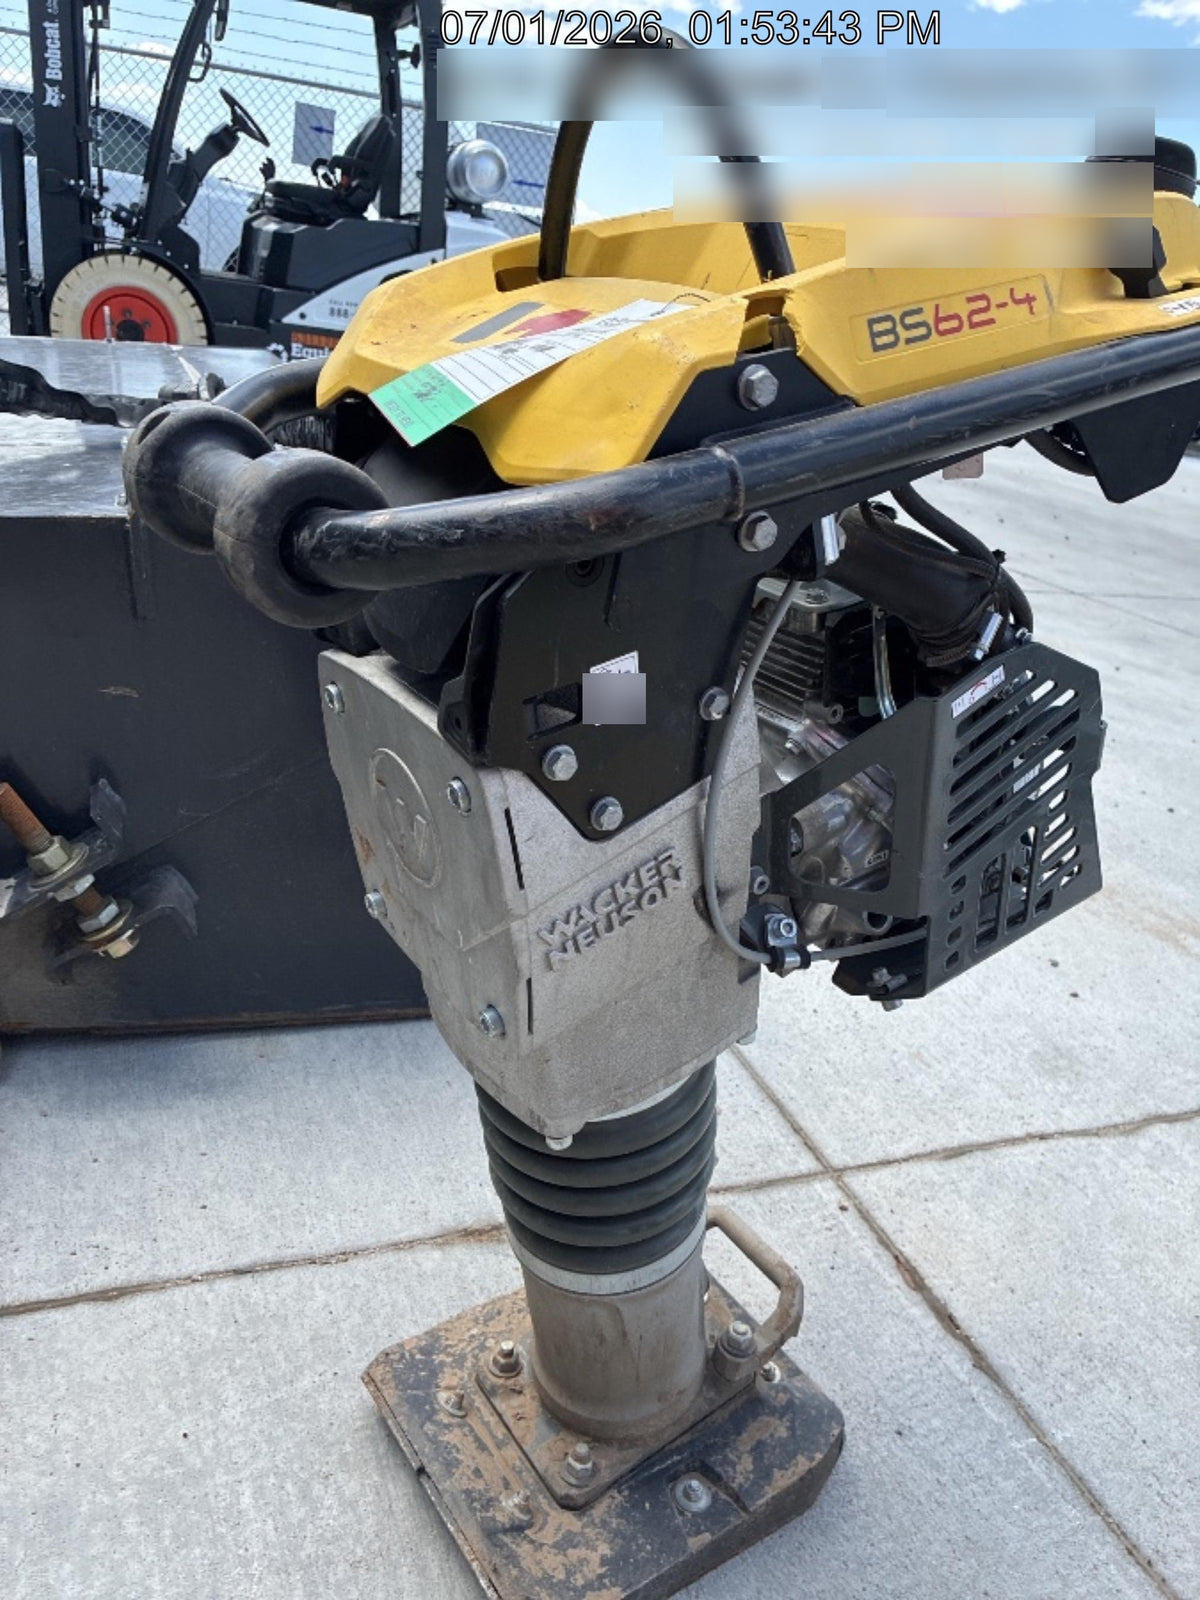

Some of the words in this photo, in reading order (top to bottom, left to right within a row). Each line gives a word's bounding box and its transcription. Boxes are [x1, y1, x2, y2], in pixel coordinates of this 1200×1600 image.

[42, 20, 63, 80] Bobcat
[867, 287, 1037, 353] BS62-4
[538, 846, 679, 946] WACKER
[546, 866, 687, 972] NEUSON
